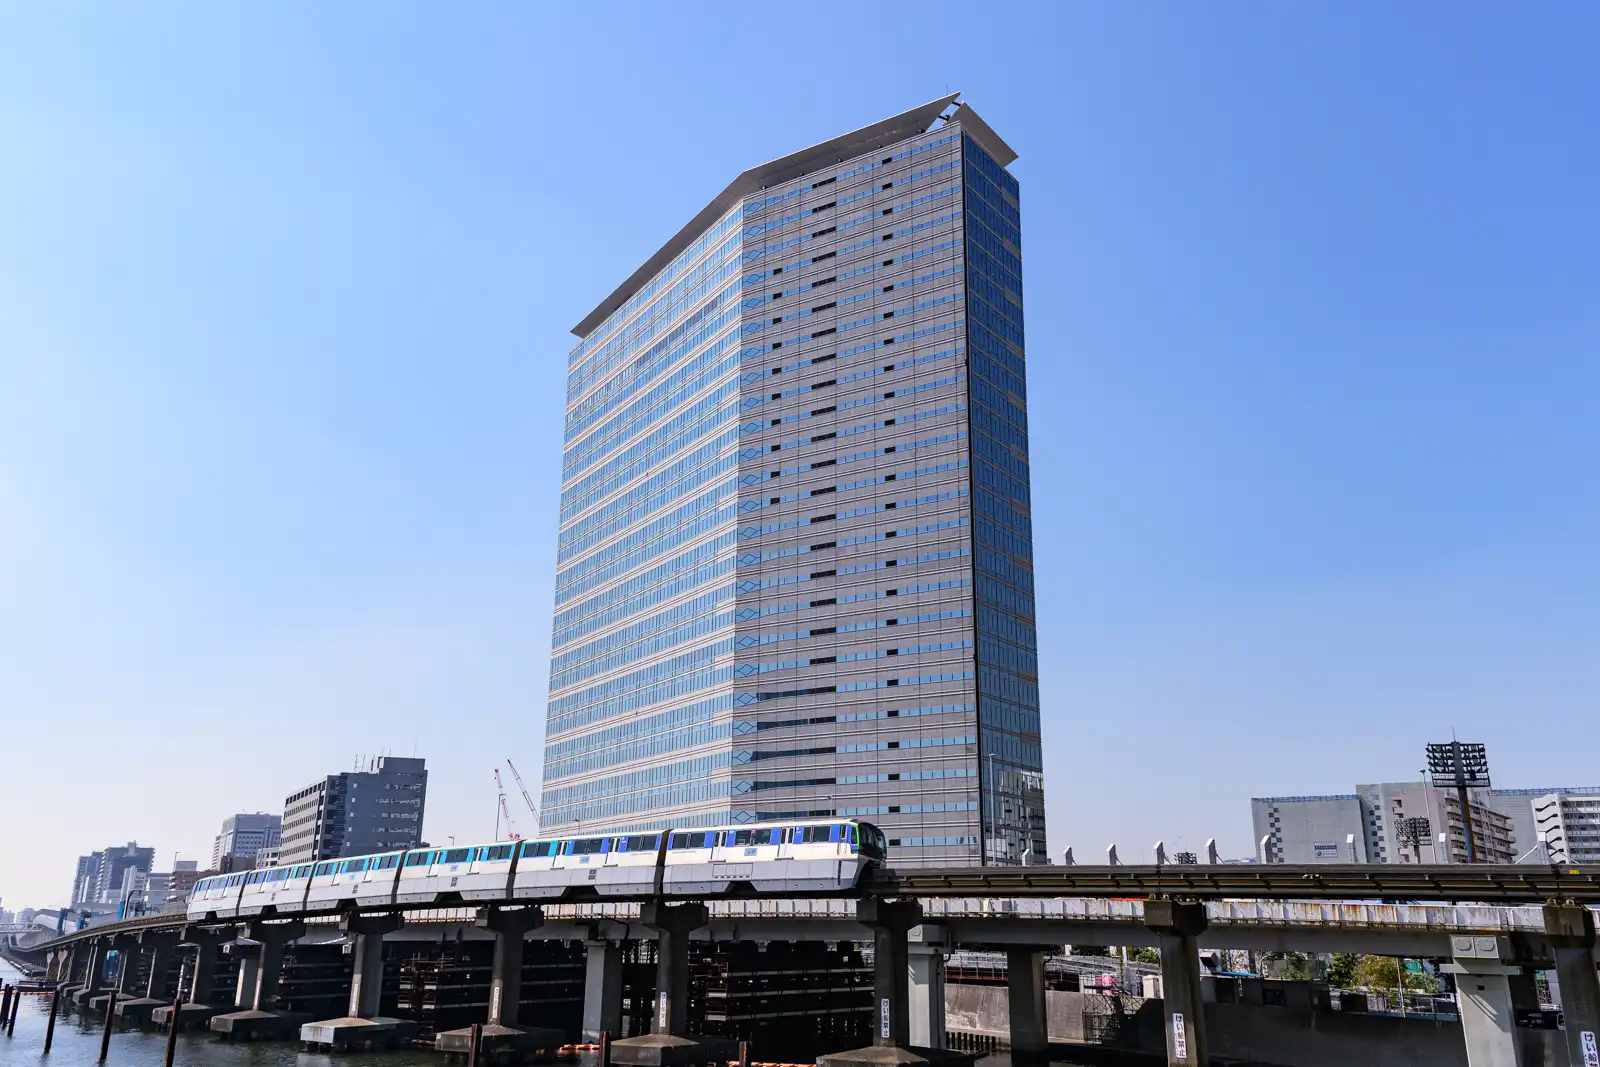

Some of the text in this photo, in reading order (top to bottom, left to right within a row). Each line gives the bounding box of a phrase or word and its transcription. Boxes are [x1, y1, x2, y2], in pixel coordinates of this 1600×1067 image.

[1176, 1014, 1186, 1057] けい船禁止
